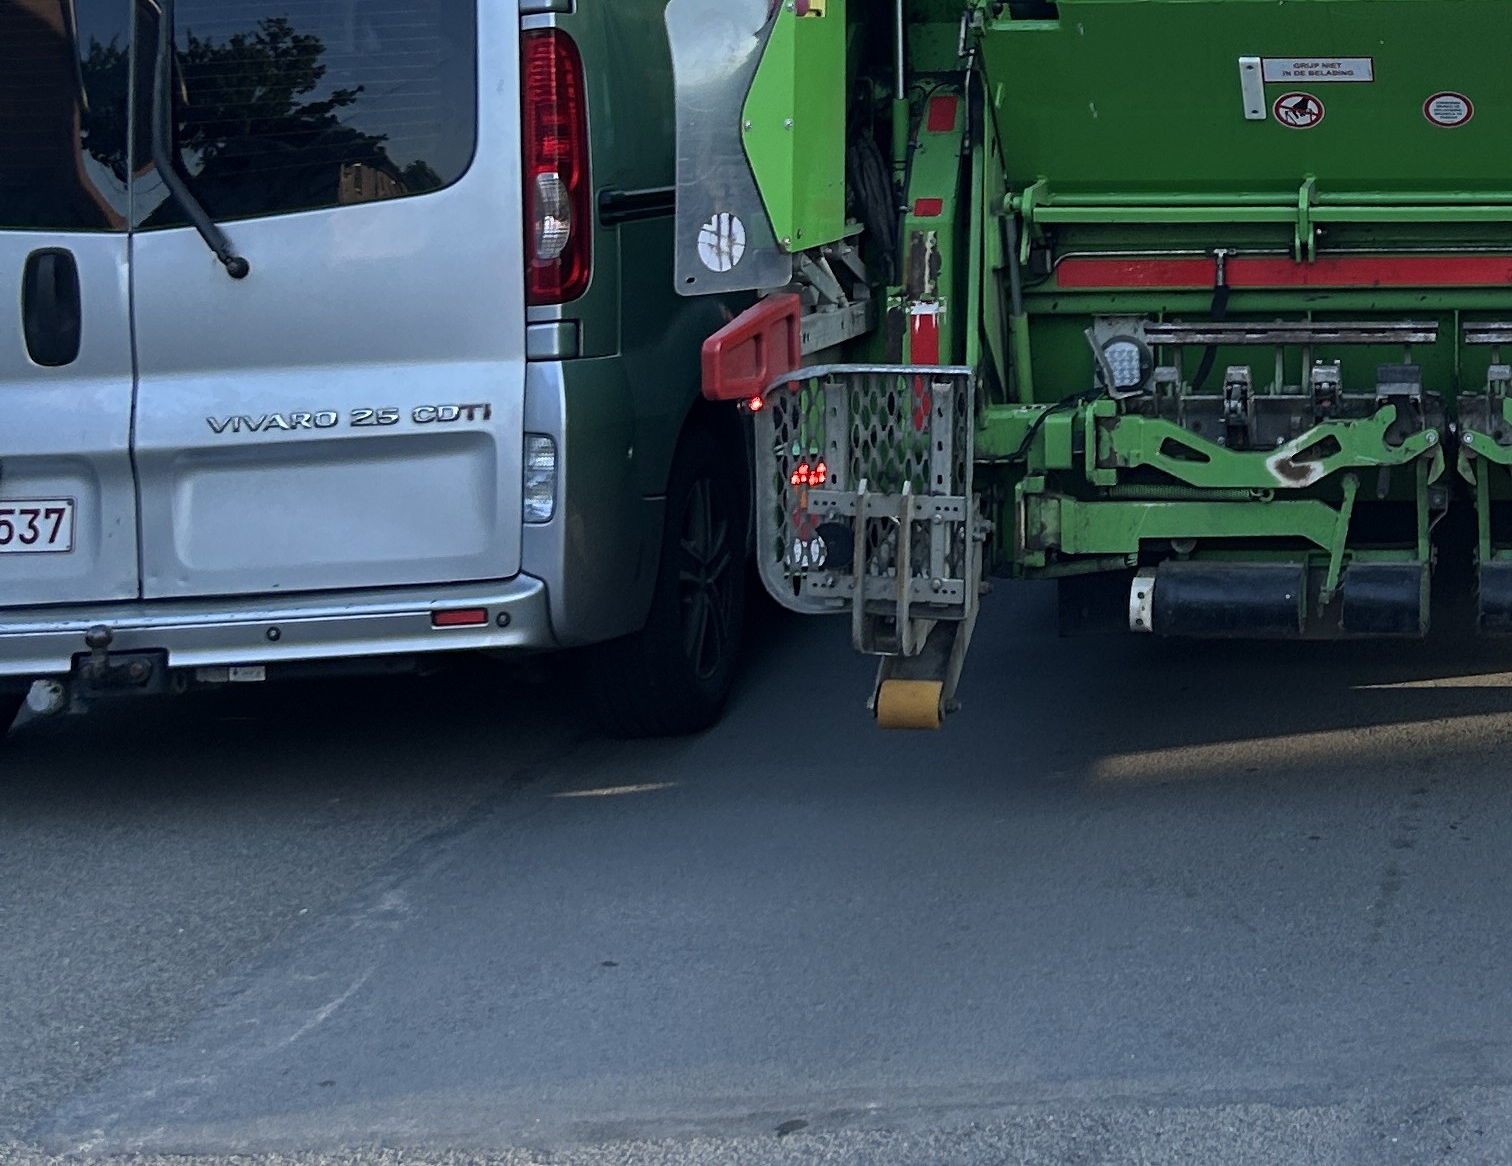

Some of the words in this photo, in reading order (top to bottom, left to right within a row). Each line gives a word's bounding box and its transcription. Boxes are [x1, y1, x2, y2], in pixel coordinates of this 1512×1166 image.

[205, 410, 339, 434] VIVARO
[411, 402, 492, 424] CDTI
[0, 507, 66, 546] 537
